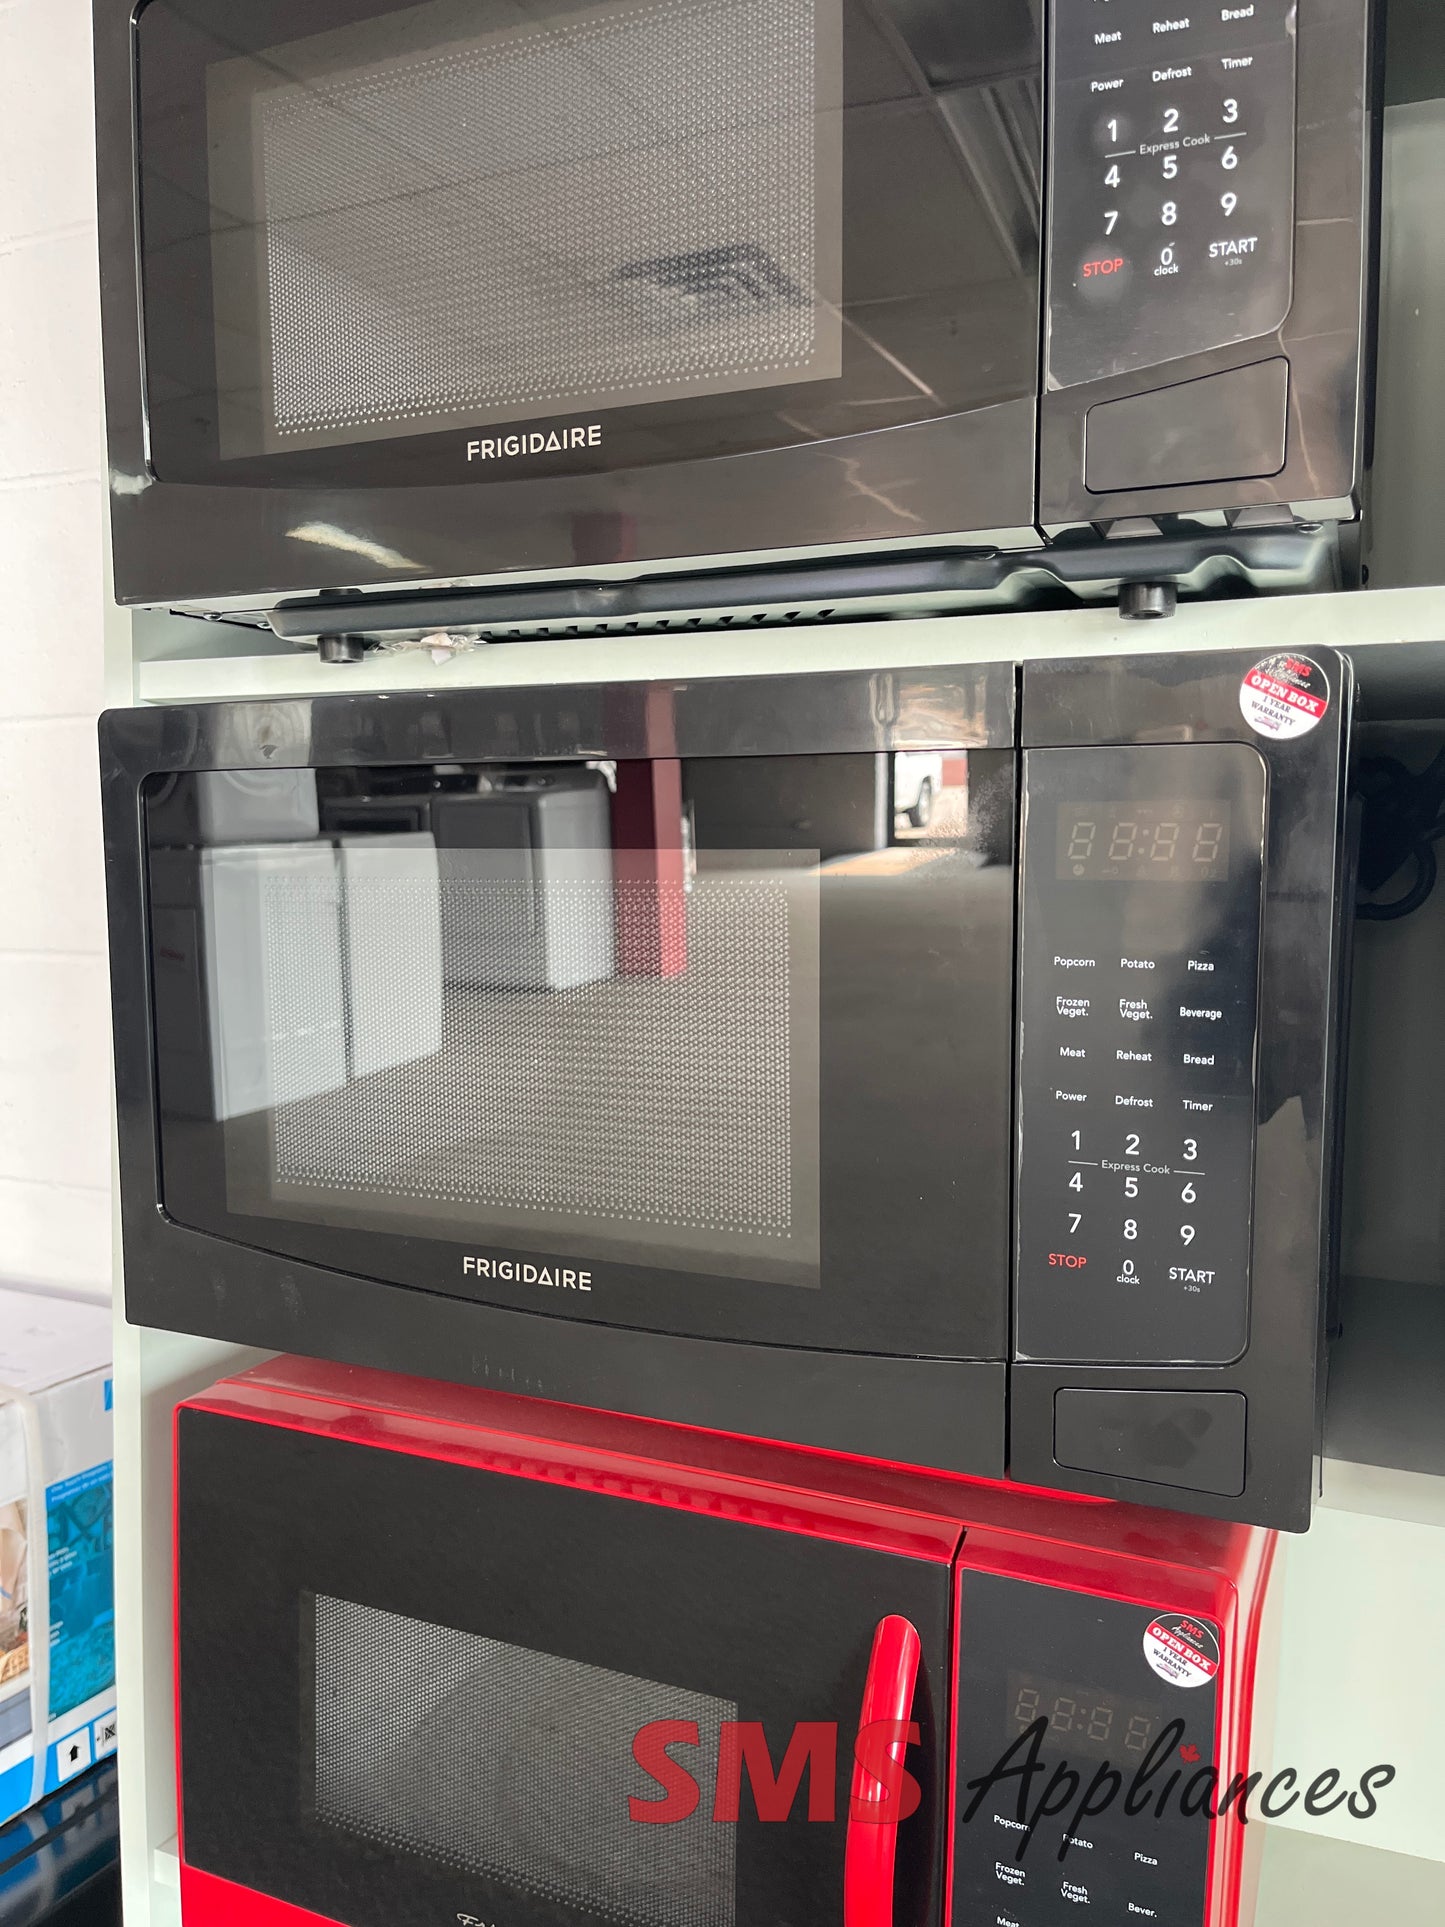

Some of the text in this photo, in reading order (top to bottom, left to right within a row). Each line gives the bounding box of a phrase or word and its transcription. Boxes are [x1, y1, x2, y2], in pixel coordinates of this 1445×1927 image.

[1221, 5, 1254, 21] Bread
[1152, 18, 1190, 34] Reheat
[1094, 31, 1122, 44] Meat
[1221, 56, 1253, 70] Timer
[1152, 67, 1192, 82] Defrost
[1091, 78, 1124, 92] Power
[1222, 98, 1239, 123] 3
[1163, 108, 1179, 133] 2
[1107, 119, 1117, 142] 1
[1139, 134, 1211, 156] Express Cook
[1221, 146, 1238, 170] 6
[1162, 155, 1178, 179] 5
[1104, 165, 1121, 188] 4
[1220, 192, 1237, 216] 9
[1161, 201, 1177, 226] 8
[1104, 211, 1119, 235] 7
[1209, 237, 1258, 258] START
[1161, 247, 1173, 265] 0
[1082, 258, 1124, 278] STOP
[1153, 264, 1179, 276] clock
[467, 424, 601, 462] FRIGIDAIRE
[1251, 675, 1319, 713] OPEN BOX
[1251, 700, 1296, 726] WARRANTY
[1270, 698, 1291, 713] YEAR
[1054, 956, 1096, 969] Popcorn
[1120, 958, 1156, 970] Potato
[1187, 960, 1215, 972] Pizza
[1056, 996, 1090, 1008] Frozen
[1119, 999, 1148, 1010] Fresh
[1056, 1005, 1089, 1018] Veget.
[1120, 1008, 1153, 1021] Veget.
[1179, 1006, 1223, 1021] Beverage
[1059, 1046, 1086, 1058] Meat
[1116, 1050, 1152, 1062] Reheat
[1183, 1054, 1215, 1065] Bread
[1055, 1090, 1087, 1102] Power
[1115, 1095, 1153, 1108] Defrost
[1182, 1100, 1213, 1112] Timer
[1071, 1130, 1081, 1151] 1
[1125, 1133, 1140, 1156] 2
[1182, 1138, 1198, 1161] 3
[1101, 1159, 1171, 1175] Express Cook
[1068, 1171, 1083, 1192] 4
[1124, 1176, 1139, 1198] 5
[1181, 1182, 1197, 1204] 6
[1068, 1213, 1082, 1233] 7
[1123, 1218, 1138, 1240] 8
[1180, 1224, 1195, 1246] 9
[1048, 1253, 1087, 1269] STOP
[1122, 1259, 1134, 1275] 0
[463, 1256, 592, 1291] FRIGIDAIRE
[1116, 1274, 1140, 1285] clock
[1169, 1266, 1216, 1286] START
[1180, 1619, 1205, 1639] SMS
[1152, 1626, 1211, 1671] OPEN BOX
[1153, 1648, 1192, 1678] WARRANTY
[1168, 1649, 1188, 1666] YEAR
[1134, 1852, 1158, 1866] Pizza
[995, 1862, 1026, 1878] Frozen
[996, 1870, 1025, 1886] Veget.
[1060, 1888, 1091, 1904] Veget.
[1063, 1881, 1088, 1895] Fresh
[1128, 1902, 1158, 1918] Bever.
